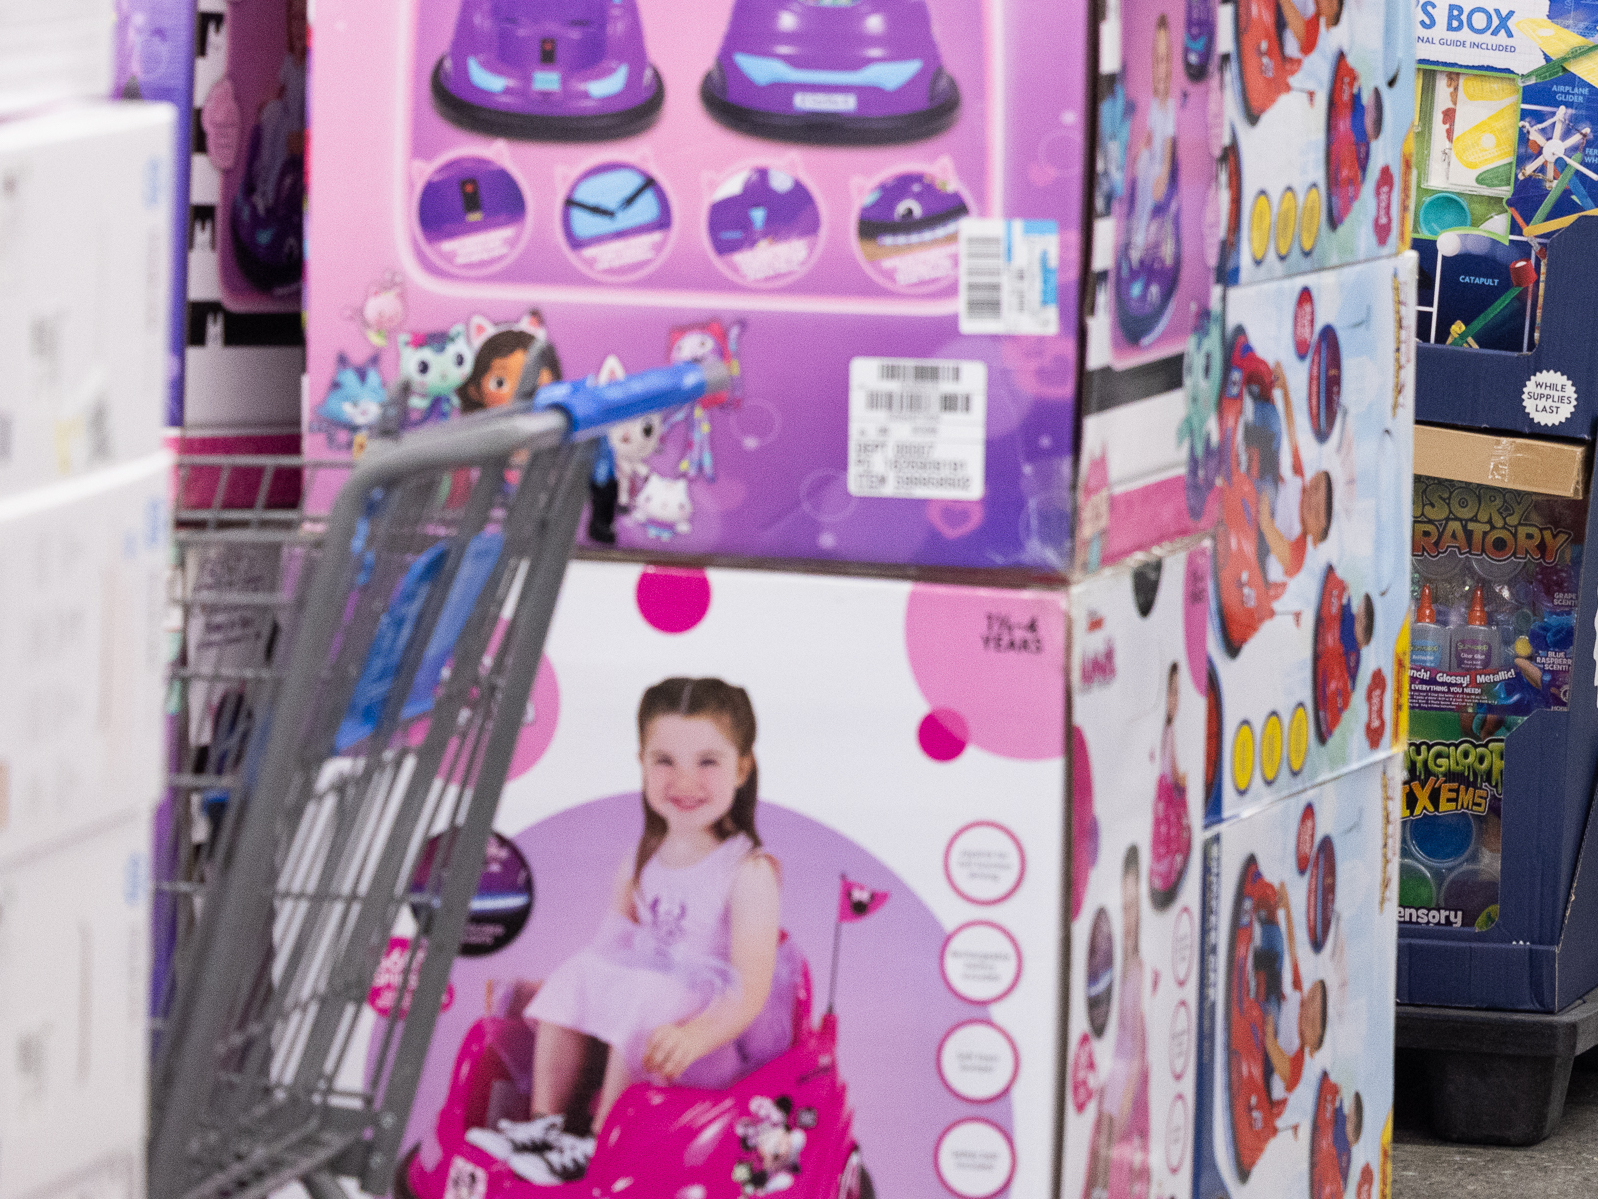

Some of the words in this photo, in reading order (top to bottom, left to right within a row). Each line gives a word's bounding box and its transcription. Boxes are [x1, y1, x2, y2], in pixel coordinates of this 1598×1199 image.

[1446, 3, 1515, 38] BOX
[1438, 37, 1467, 49] GUIDE
[1469, 41, 1516, 53] INCLUDED
[1552, 84, 1589, 95] AIRPLANE
[1556, 94, 1583, 103] GLIDER
[1459, 275, 1499, 286] CATAPULT
[1535, 380, 1567, 392] WHILE
[1527, 391, 1572, 404] SUPPLIES
[1535, 404, 1560, 414] LAST
[1413, 521, 1572, 562] RATORY
[1436, 673, 1470, 687] Glossy!
[1477, 669, 1516, 684] Metallic!
[1412, 684, 1447, 692] EVERYTHING
[1397, 906, 1463, 927] ensory
